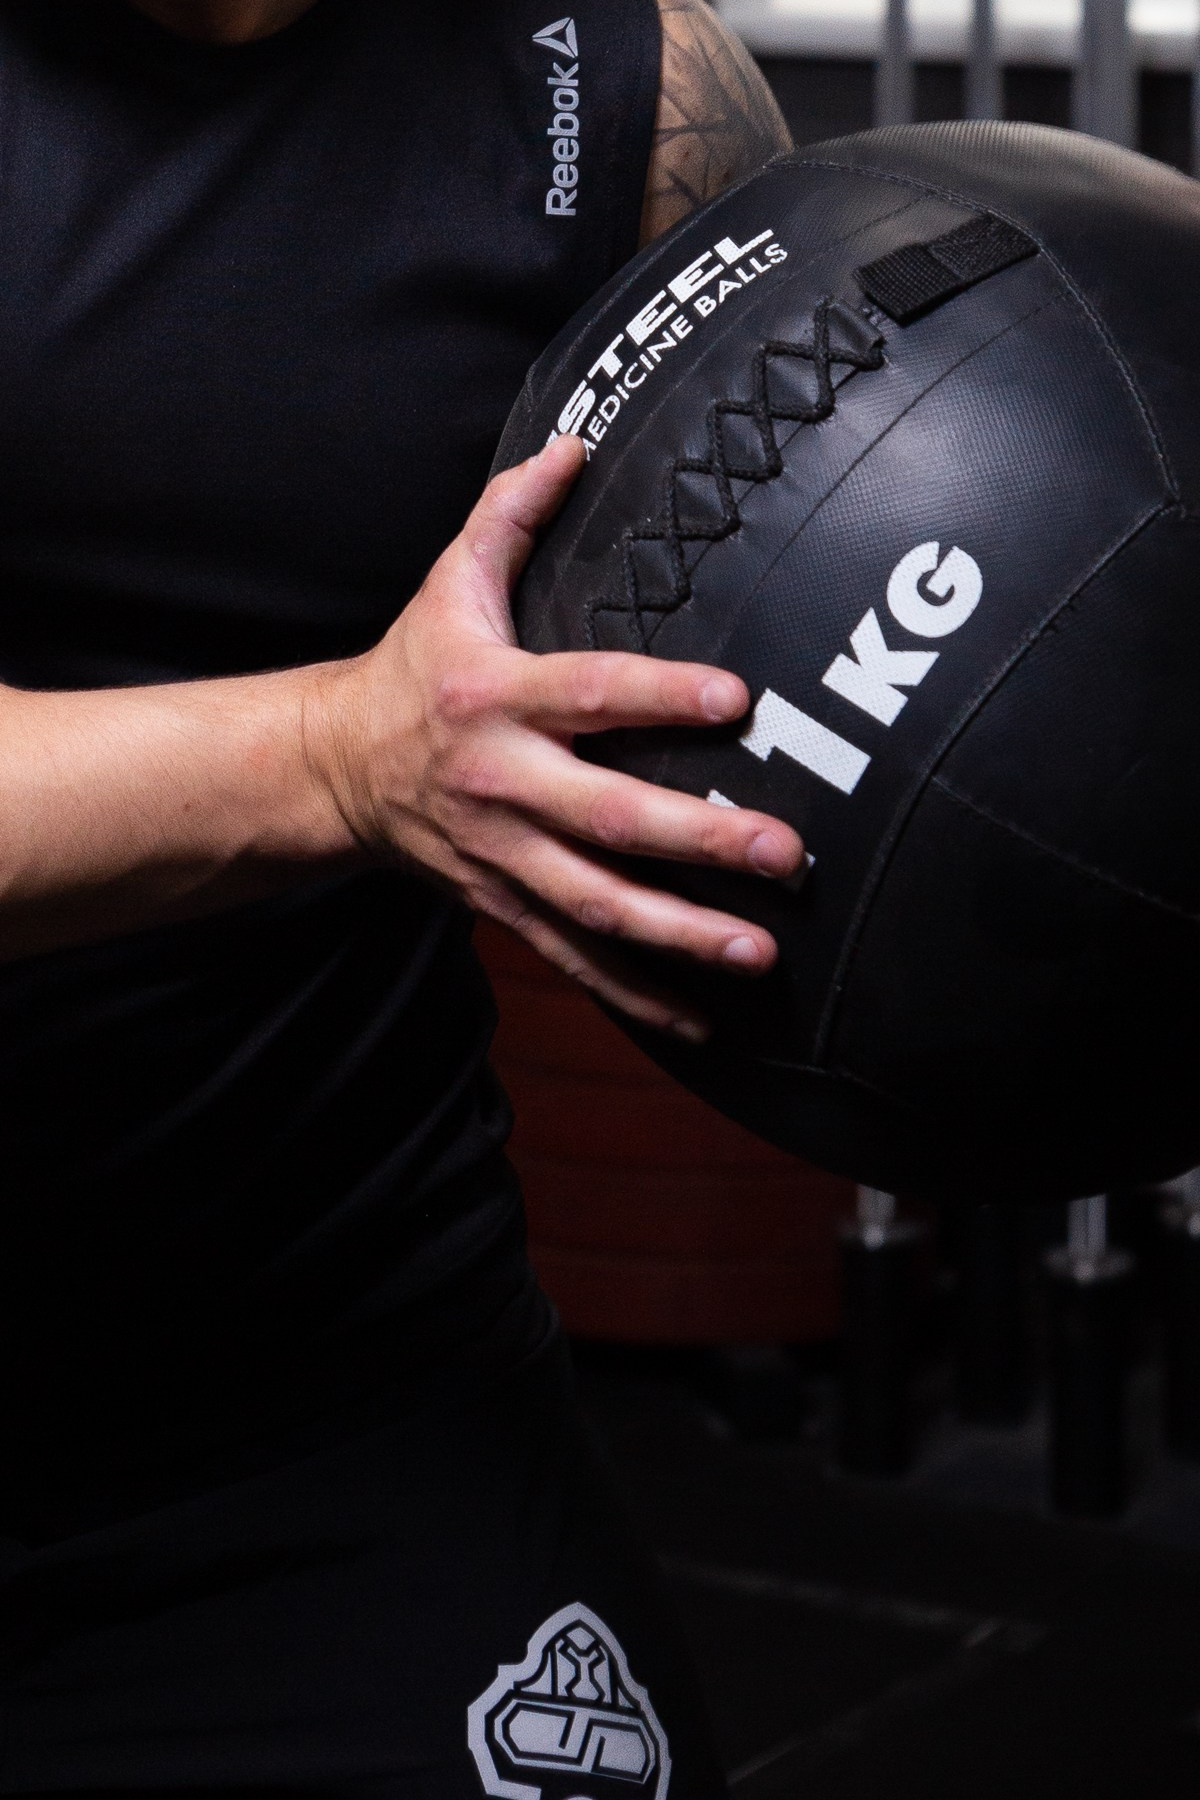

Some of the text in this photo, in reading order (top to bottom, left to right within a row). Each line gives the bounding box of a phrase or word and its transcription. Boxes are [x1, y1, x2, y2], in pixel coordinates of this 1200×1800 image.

[545, 62, 580, 216] Reebok
[546, 228, 774, 447] STEEL
[693, 242, 788, 318] BALLS
[821, 541, 983, 727] KG
